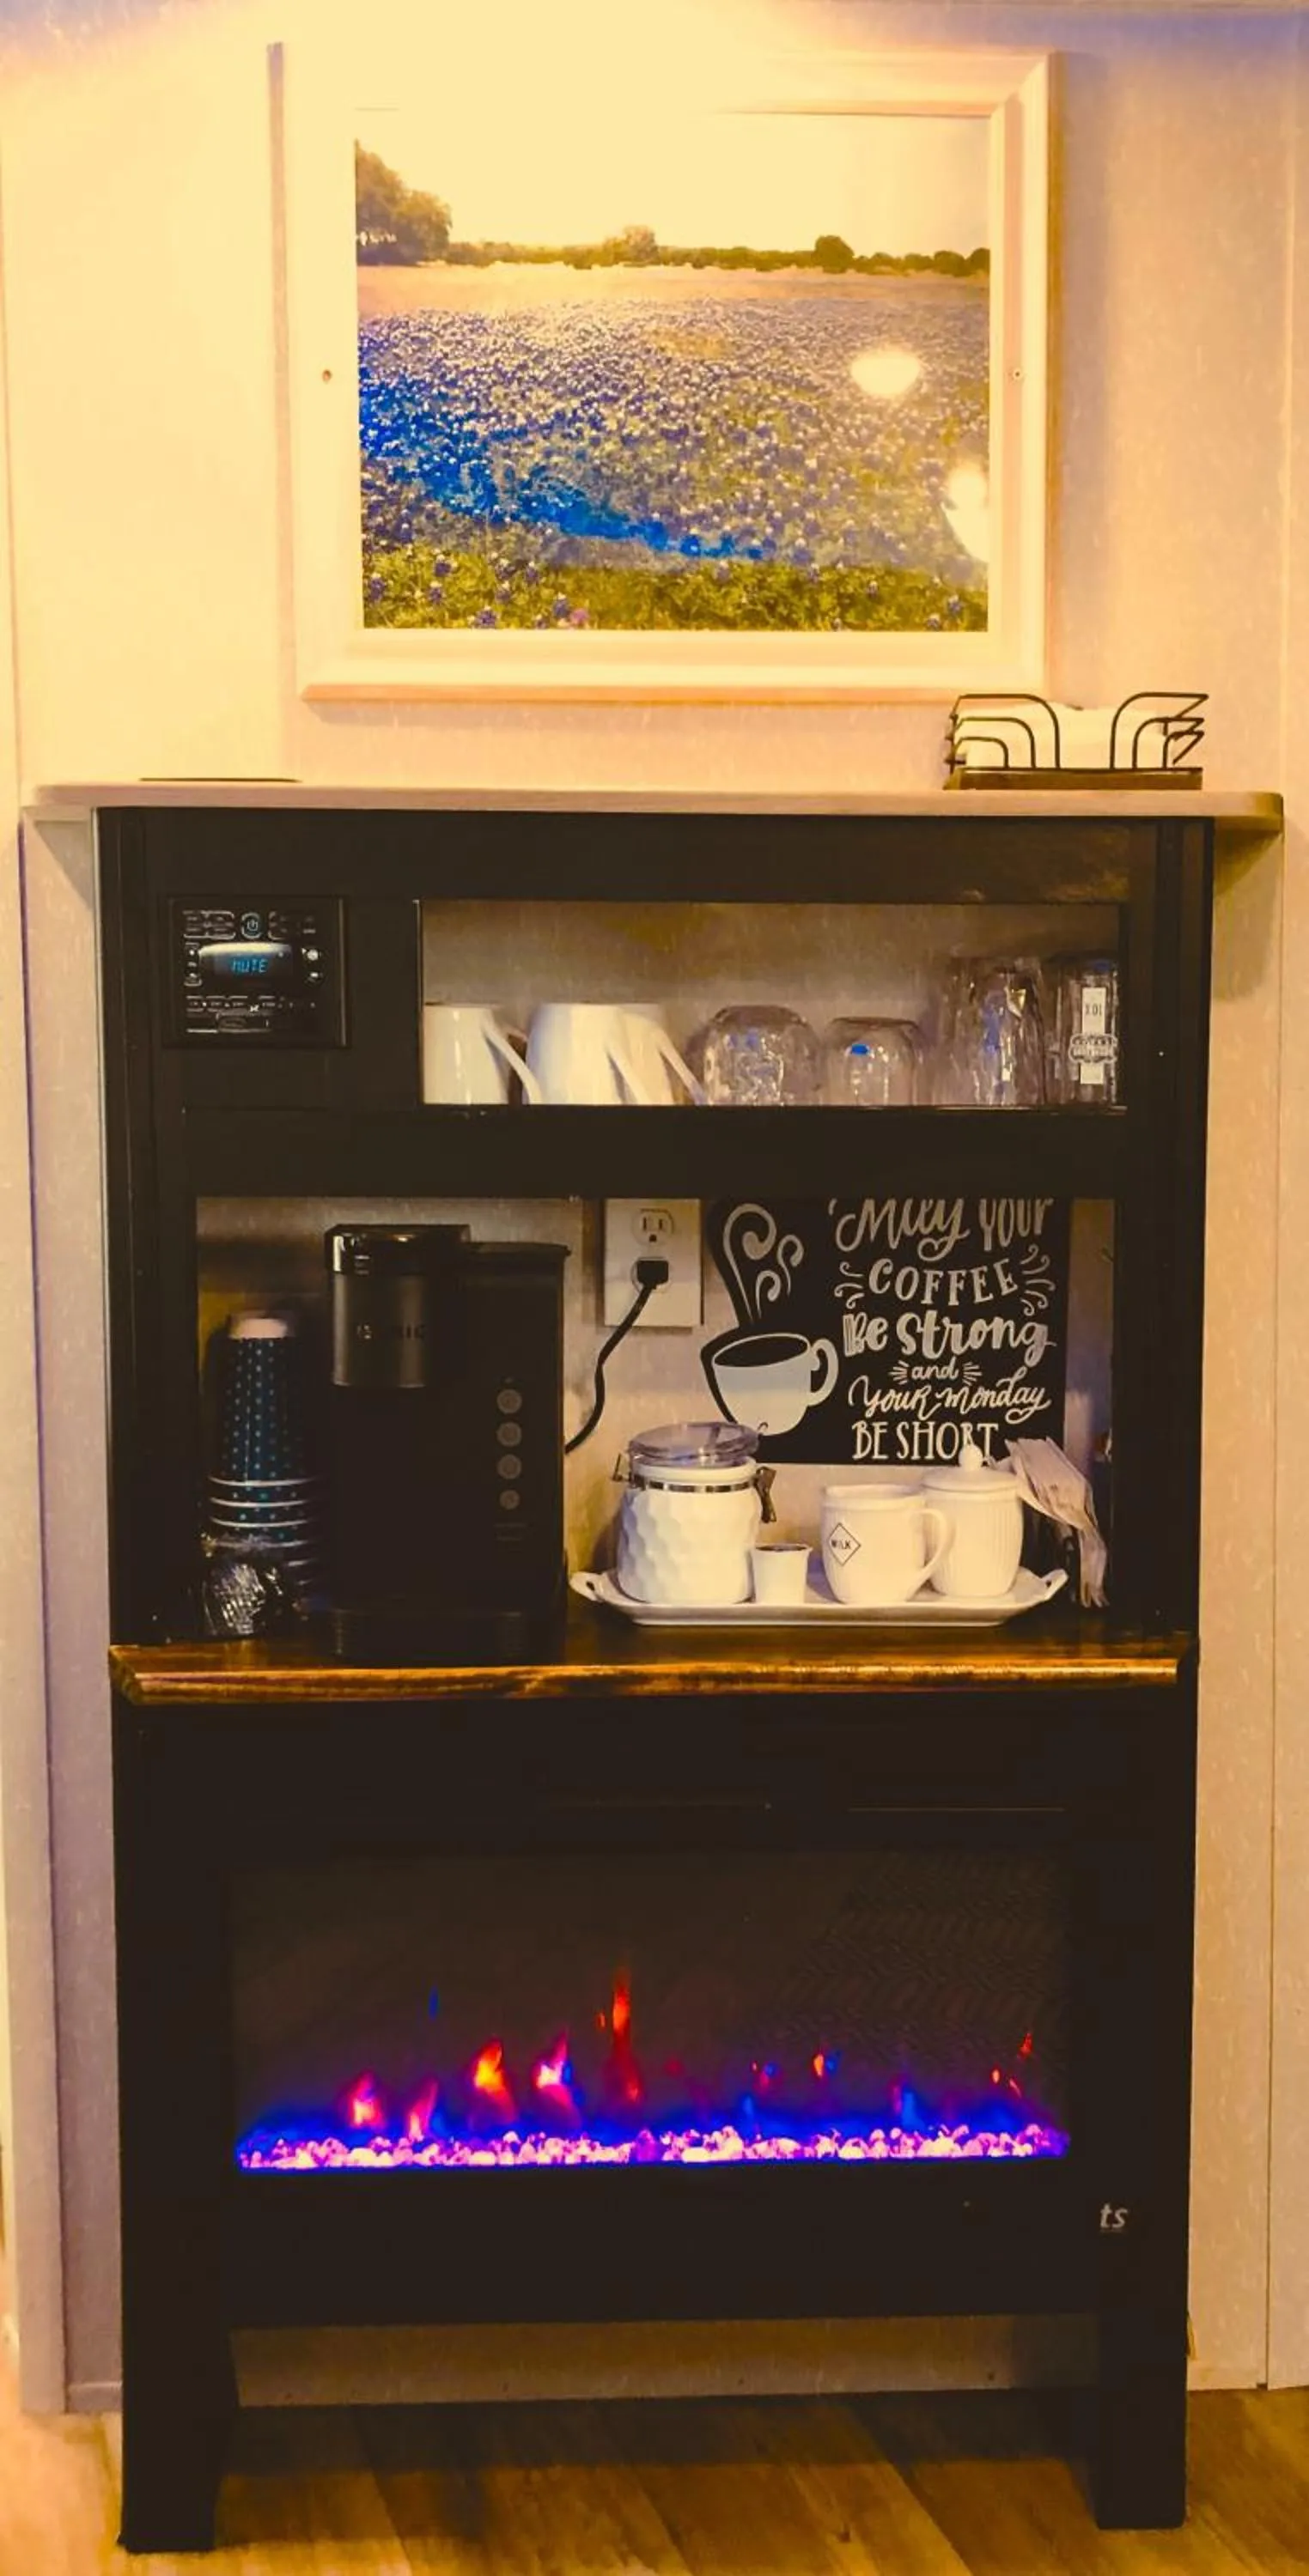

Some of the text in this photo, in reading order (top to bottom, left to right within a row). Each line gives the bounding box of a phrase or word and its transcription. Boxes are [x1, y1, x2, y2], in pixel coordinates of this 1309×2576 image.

[828, 1199, 971, 1261] May
[868, 1258, 1018, 1306] COFFEE
[843, 1312, 888, 1357] Be
[911, 1357, 959, 1381] and
[852, 1420, 889, 1460] BE
